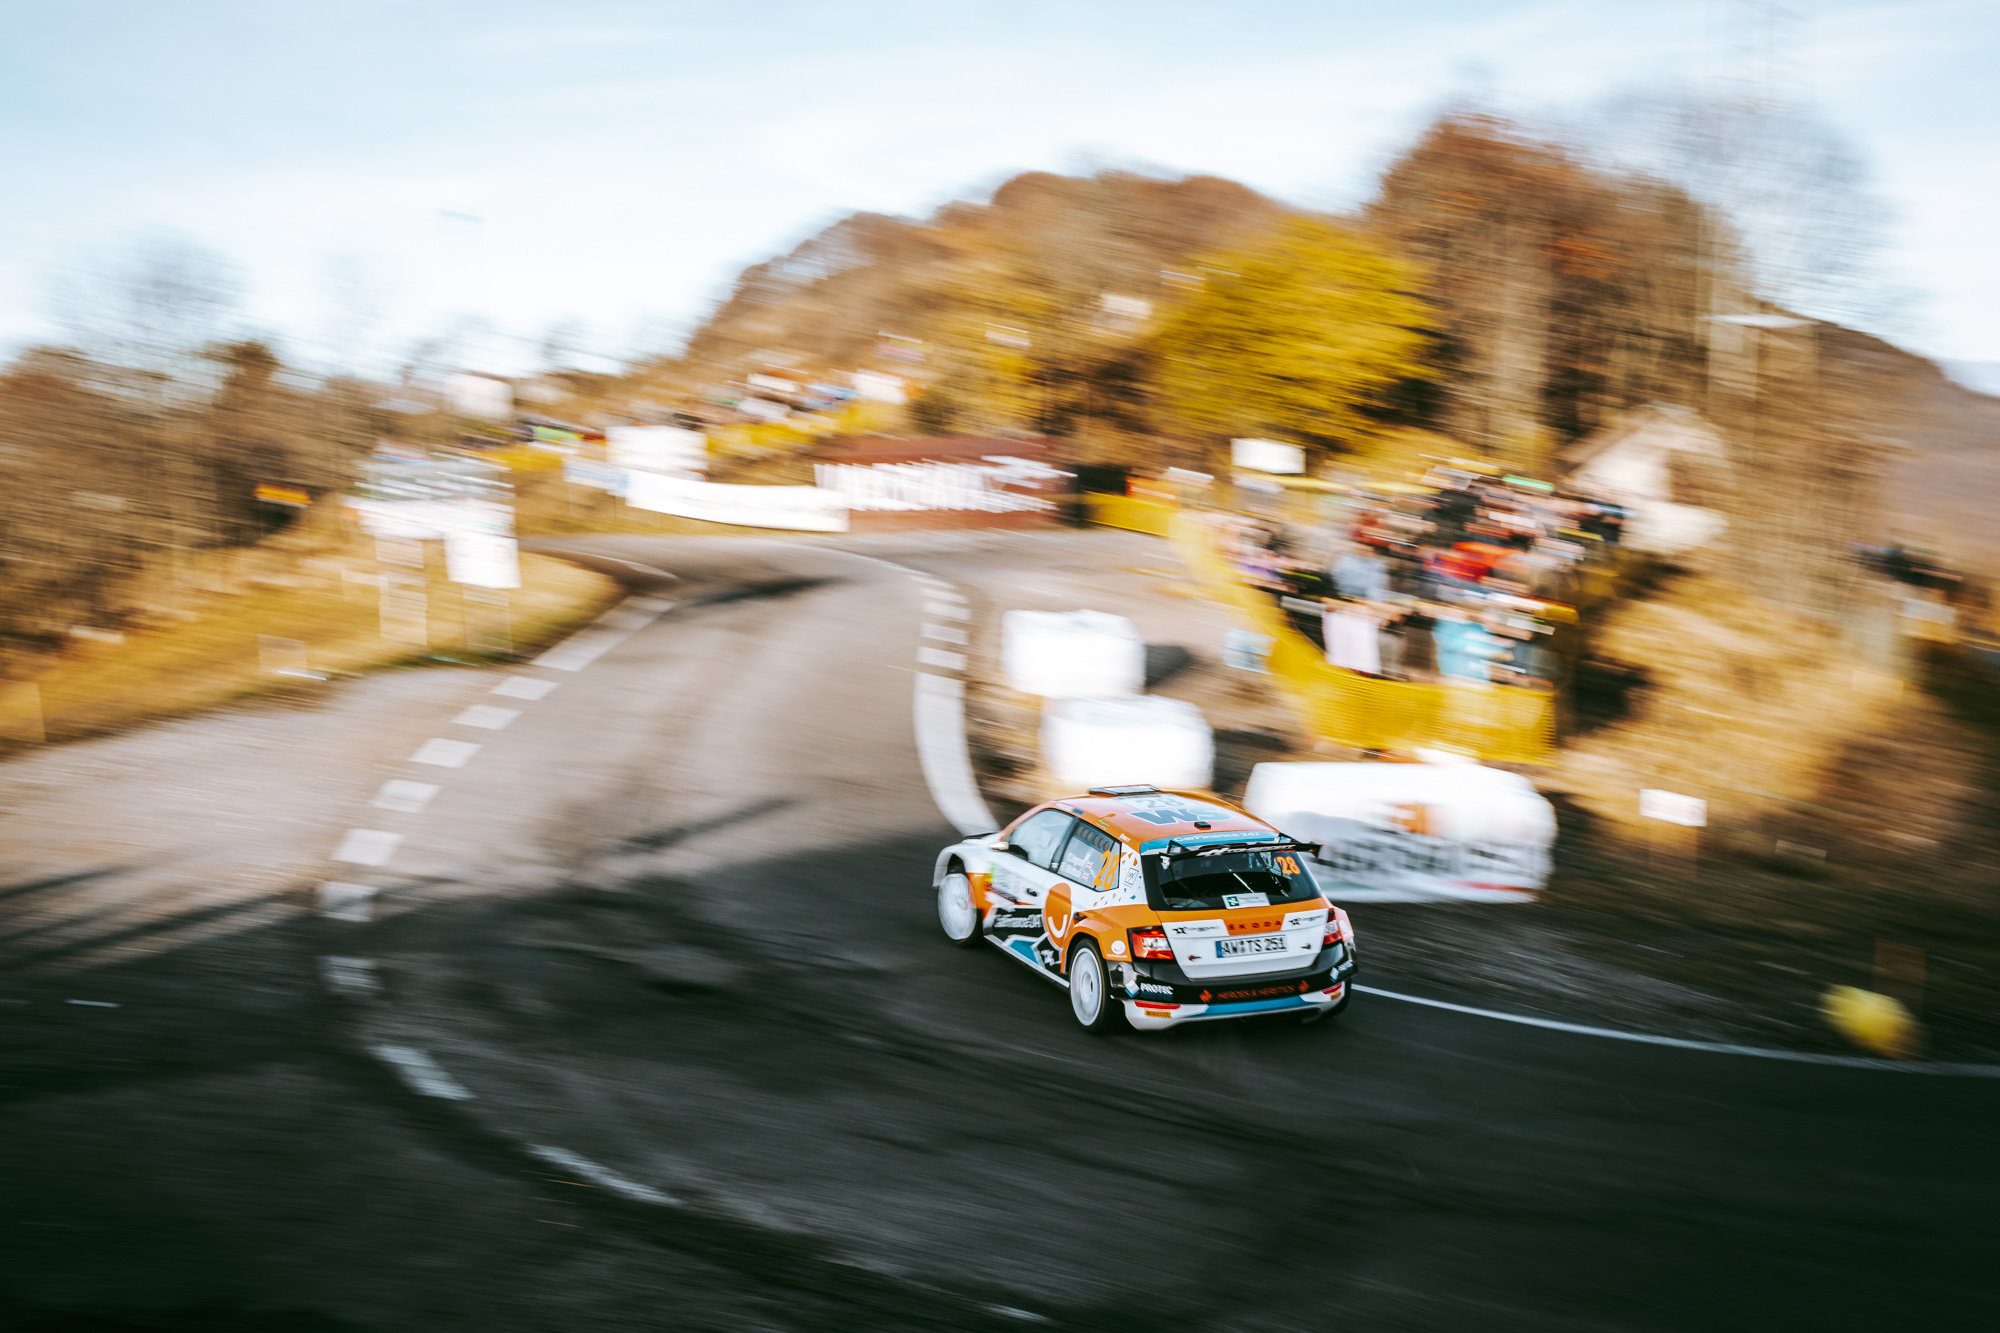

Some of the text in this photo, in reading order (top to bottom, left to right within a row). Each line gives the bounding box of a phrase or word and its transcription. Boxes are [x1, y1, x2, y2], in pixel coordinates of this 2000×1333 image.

[1126, 808, 1233, 826] WS
[1093, 849, 1120, 891] 28
[1276, 856, 1301, 875] 28
[1222, 937, 1287, 955] AW TS 251
[1140, 982, 1174, 995] PROTEC
